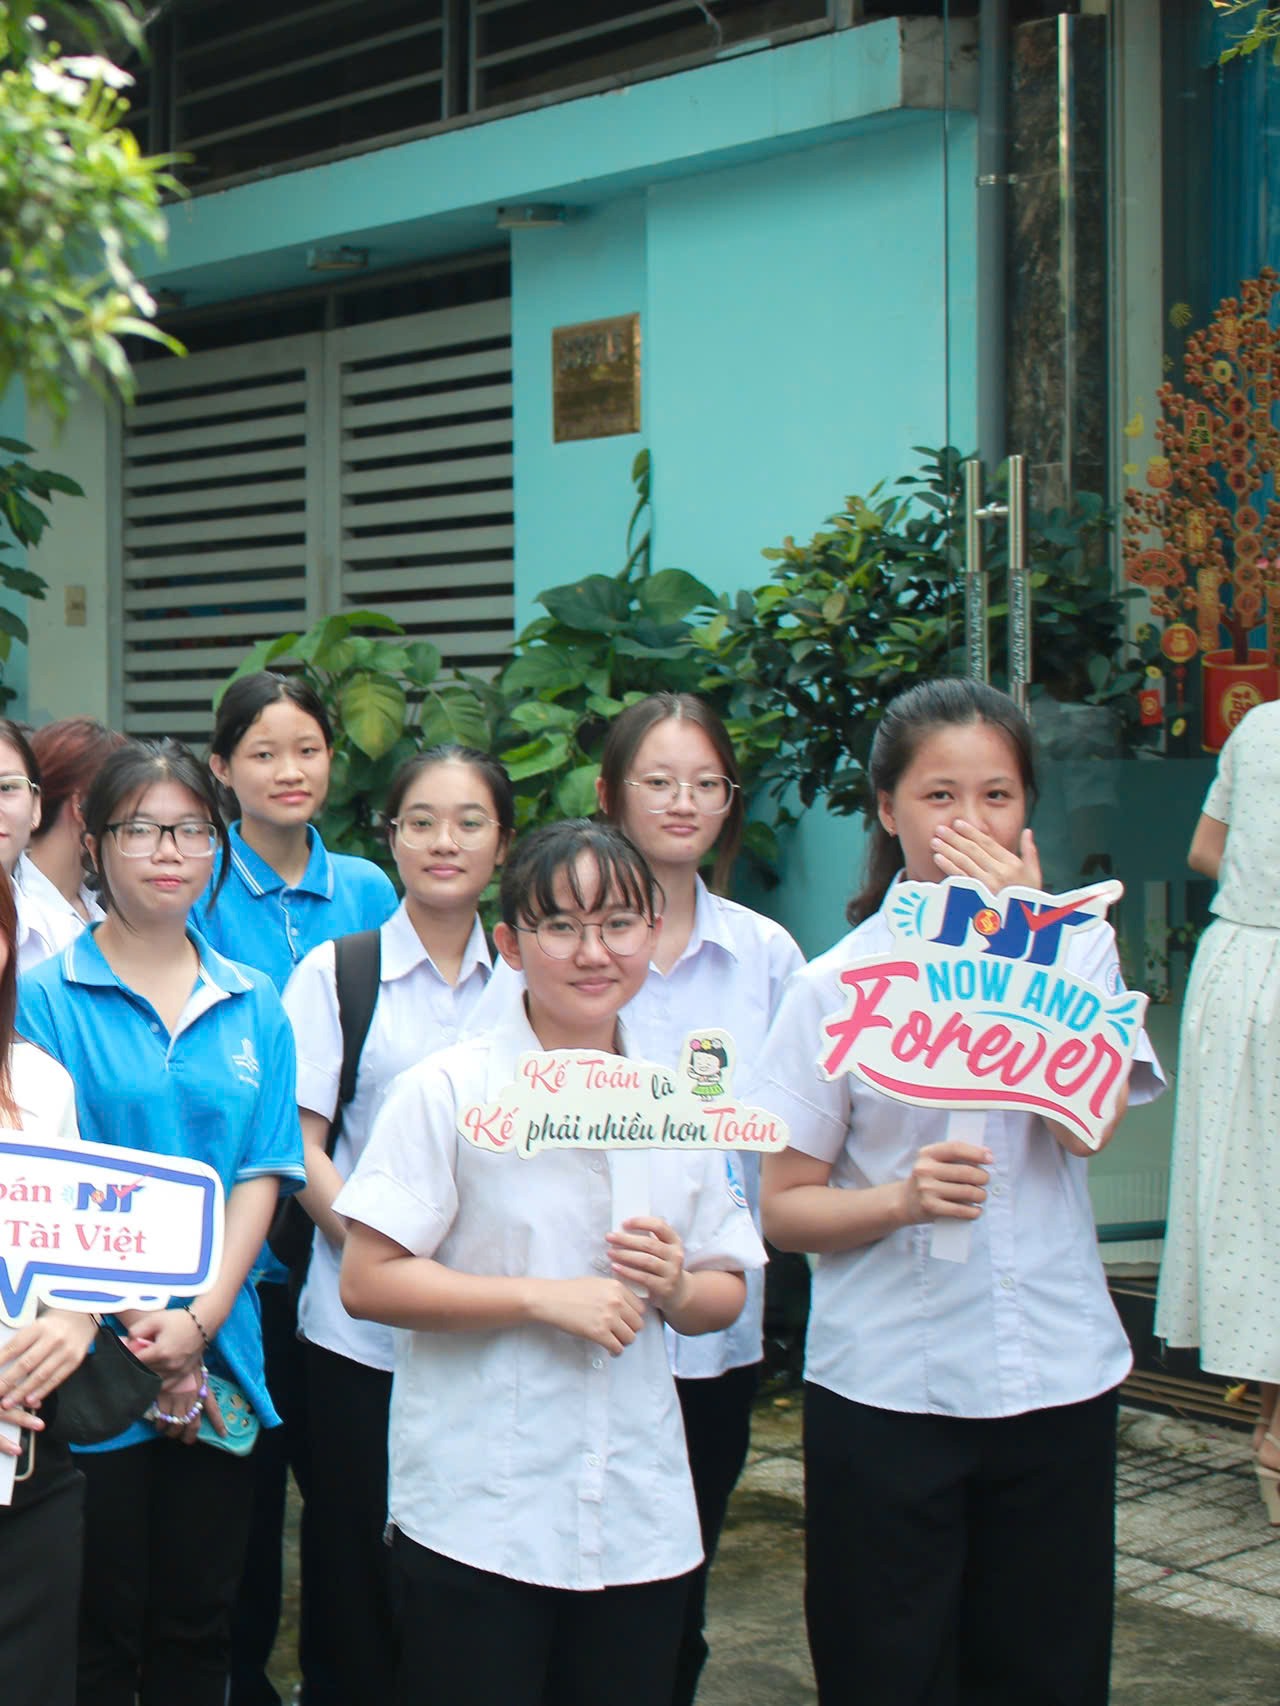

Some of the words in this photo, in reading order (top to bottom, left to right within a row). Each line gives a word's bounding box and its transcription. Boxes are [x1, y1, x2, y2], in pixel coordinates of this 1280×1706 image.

[925, 960, 1013, 1004] NOW
[1022, 969, 1101, 1032] AND
[824, 961, 1122, 1119] Forever
[523, 1058, 571, 1094] Kế
[577, 1058, 640, 1090] Toán
[464, 1106, 519, 1147] Kế
[526, 1113, 581, 1151] phải
[588, 1112, 655, 1142] nhiều
[662, 1114, 707, 1142] hơn
[703, 1107, 780, 1143] Toán
[4, 1219, 60, 1250] Tài
[75, 1223, 147, 1260] Việt
